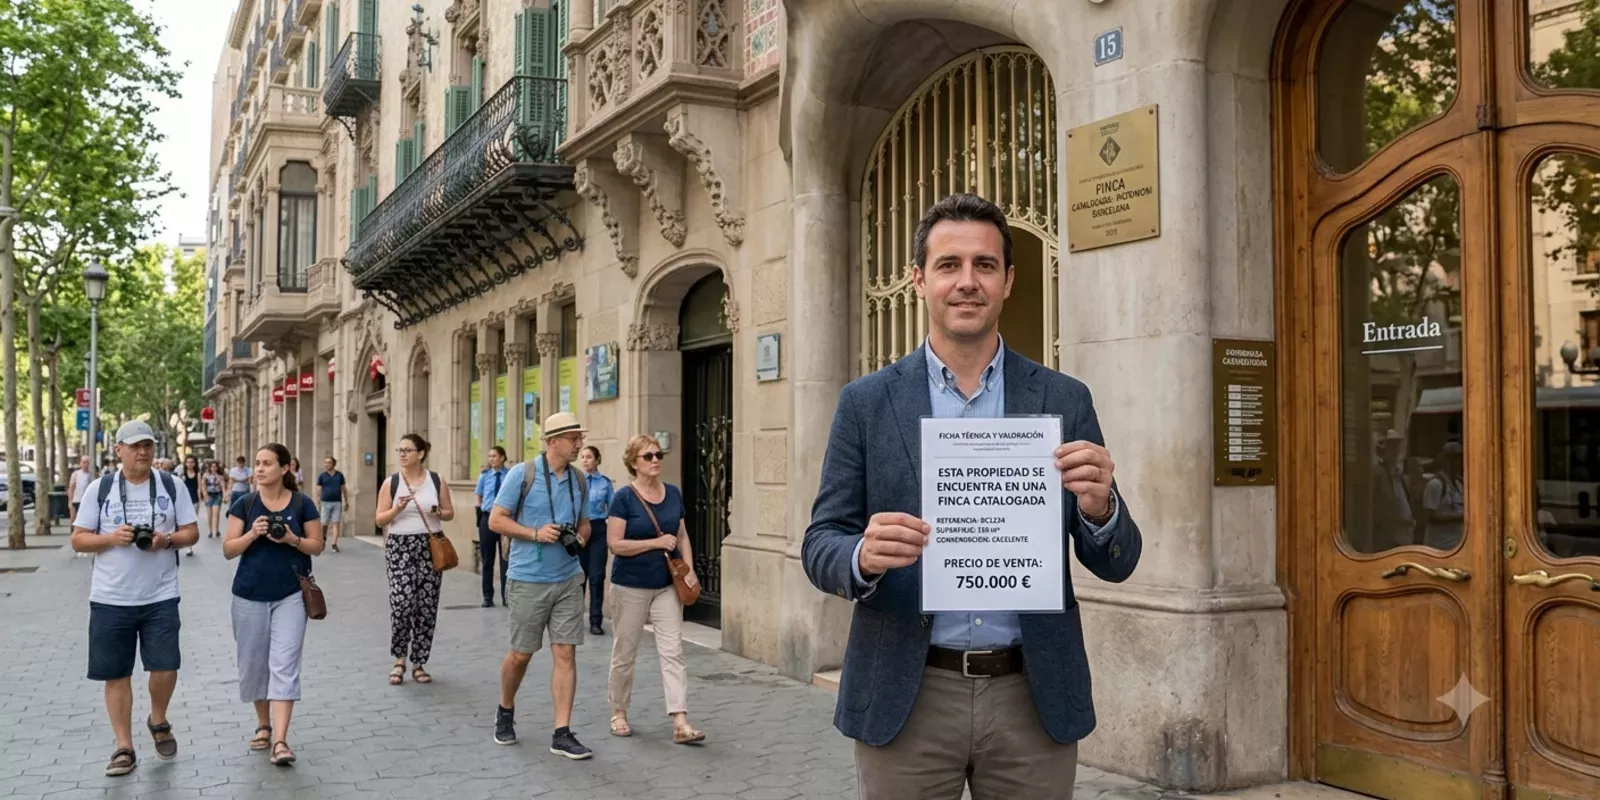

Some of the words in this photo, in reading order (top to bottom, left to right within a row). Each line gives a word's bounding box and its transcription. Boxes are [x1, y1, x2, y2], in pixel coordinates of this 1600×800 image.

[1100, 33, 1117, 59] 15
[1362, 316, 1442, 343] Entrada
[938, 467, 964, 477] ESTA
[966, 467, 1030, 477] PROPIEDAD
[1032, 467, 1045, 477] SE
[937, 482, 1003, 491] ENCUENTRA
[1005, 482, 1020, 491] EN
[1022, 481, 1047, 491] UNA
[938, 496, 971, 505] FINCA
[973, 496, 1046, 505] CATALOGADA
[944, 558, 983, 568] PRECIO
[986, 558, 1000, 568] DE
[1002, 558, 1043, 568] VENTA:
[956, 575, 1018, 589] 750.000
[1021, 575, 1032, 589] €
